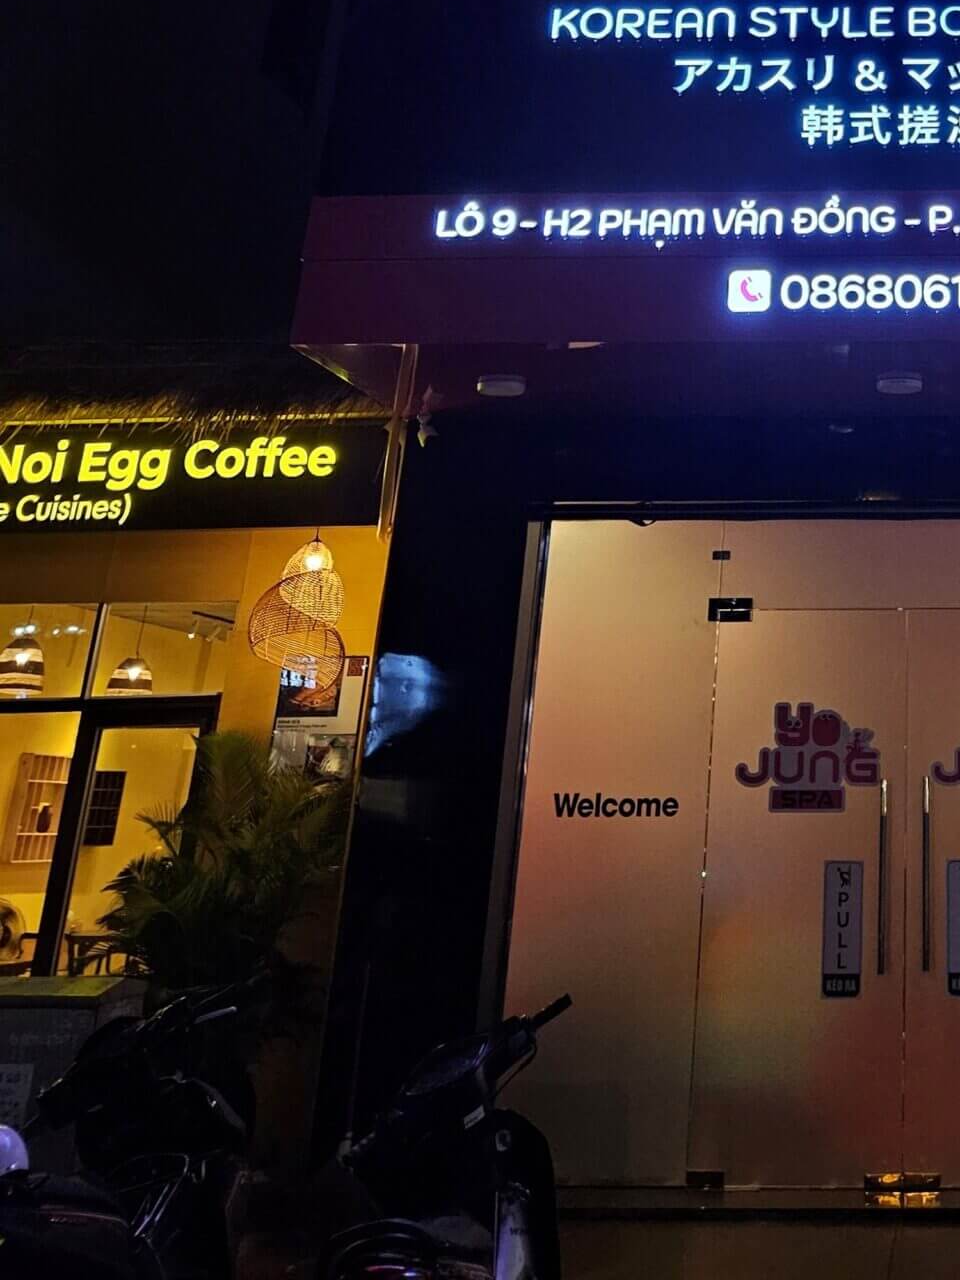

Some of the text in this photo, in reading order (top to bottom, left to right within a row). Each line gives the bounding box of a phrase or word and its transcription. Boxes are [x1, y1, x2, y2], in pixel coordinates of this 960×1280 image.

[550, 6, 737, 40] KOREAN
[748, 6, 895, 39] STYLE
[673, 55, 835, 93] アカスリ
[854, 59, 888, 92] &
[435, 201, 486, 238] LÔ
[598, 207, 706, 249] PHẠM
[712, 200, 784, 236] VĂN
[78, 442, 172, 491] Egg
[184, 436, 337, 479] Coffee
[16, 493, 132, 526] Cuisines)
[553, 792, 679, 818] Welcome
[781, 790, 834, 808] SPA
[837, 891, 850, 970] PULL
